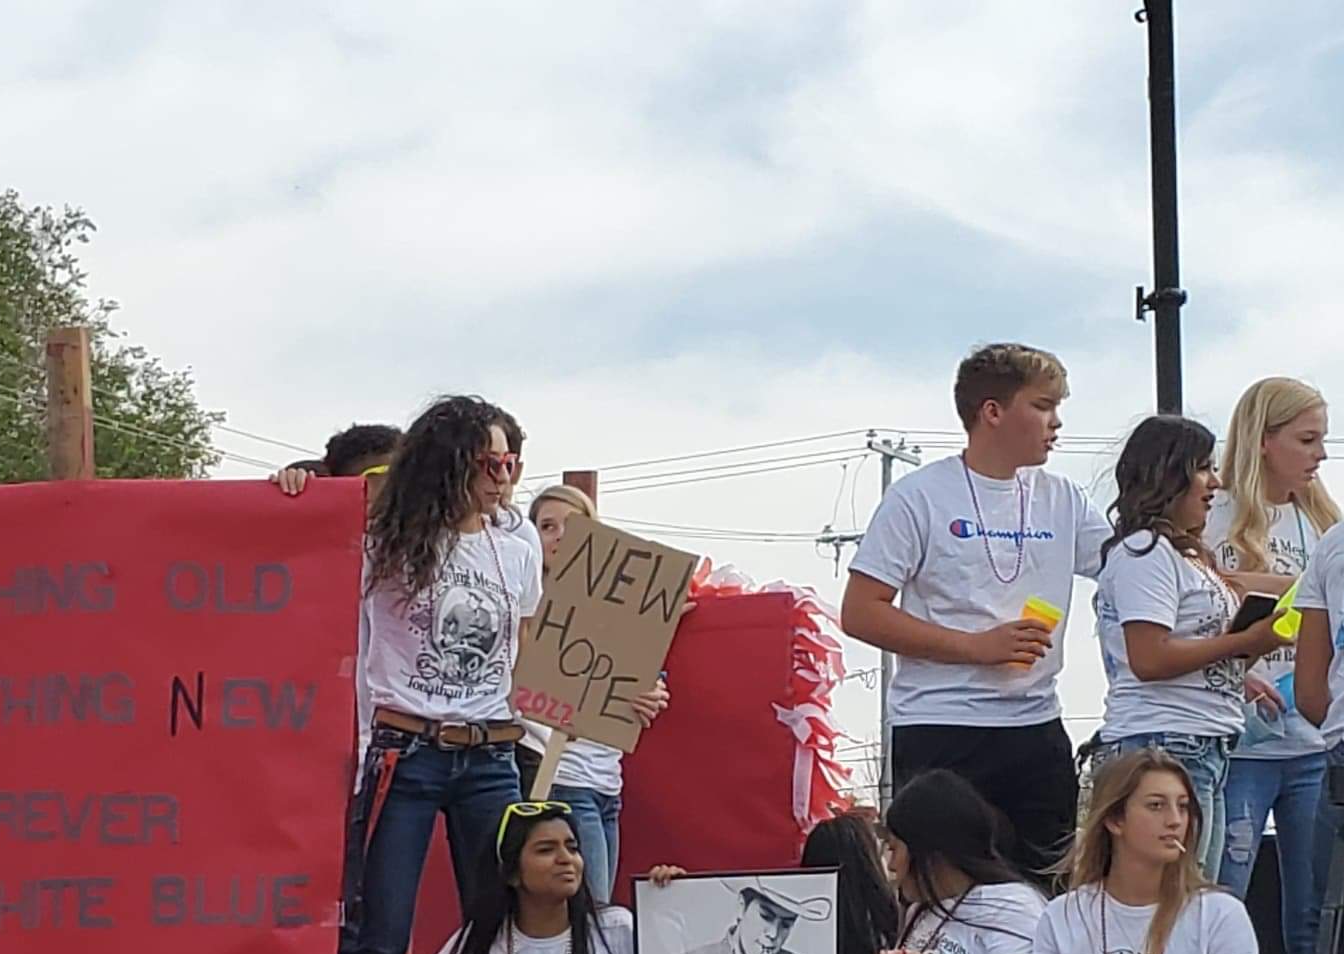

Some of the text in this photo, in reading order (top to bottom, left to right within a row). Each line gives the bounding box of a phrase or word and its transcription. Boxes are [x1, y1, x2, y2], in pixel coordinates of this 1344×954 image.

[949, 518, 1054, 546] Champion
[164, 562, 294, 616] OLD
[555, 533, 693, 624] NEW
[535, 599, 639, 724] HOPE
[170, 670, 320, 737] NEW
[513, 686, 576, 731] 2022
[150, 873, 311, 928] BLUE
